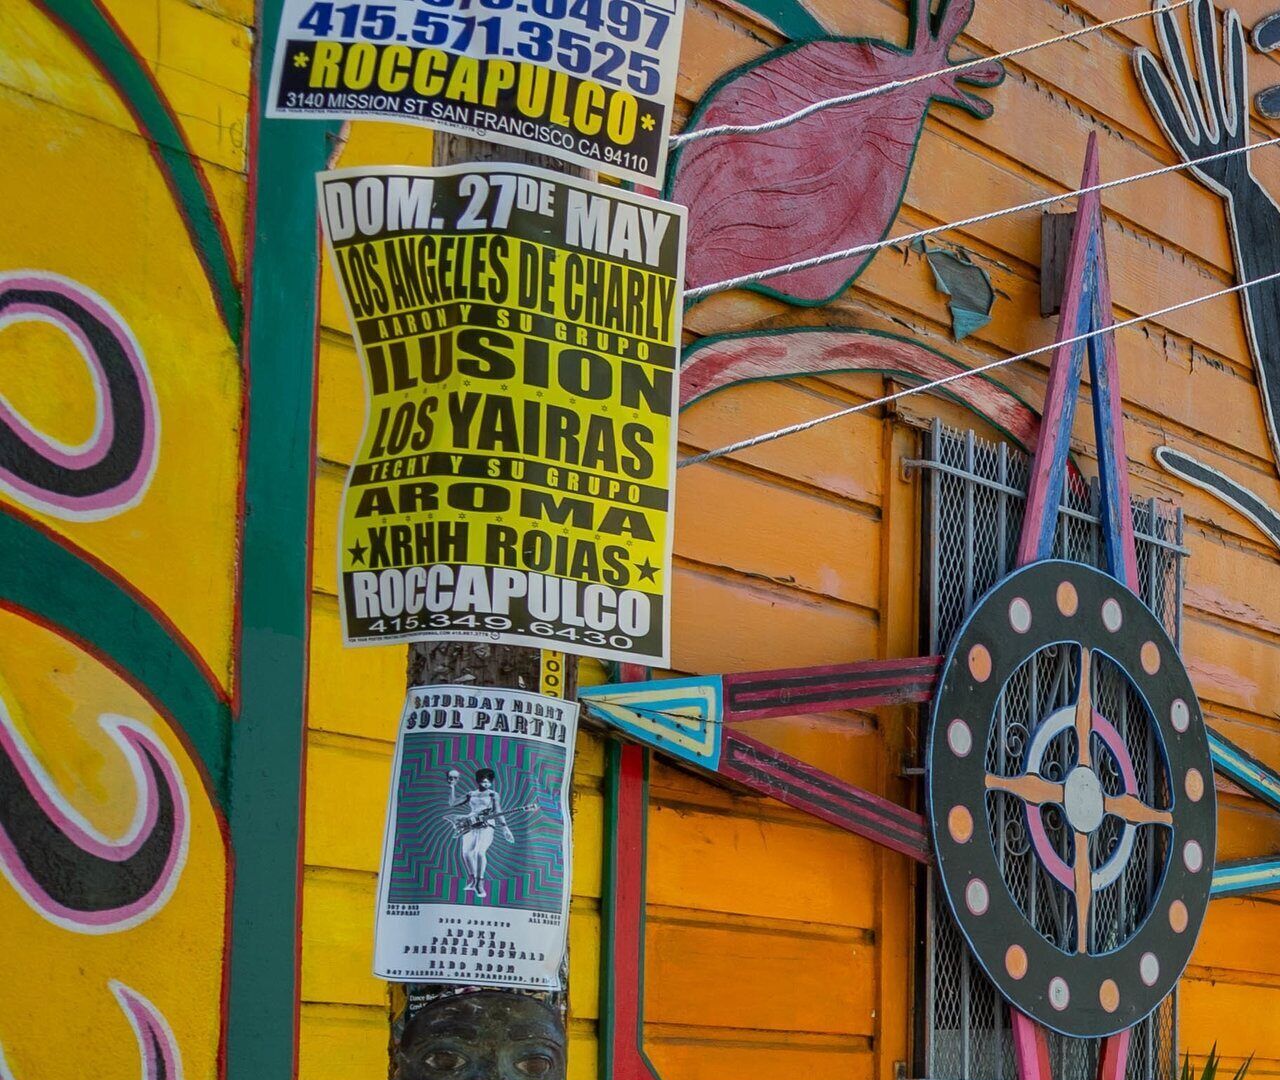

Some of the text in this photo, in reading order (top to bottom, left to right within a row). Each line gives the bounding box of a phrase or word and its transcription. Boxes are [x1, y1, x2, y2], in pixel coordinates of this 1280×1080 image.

[297, 2, 661, 96] 415.571.3525
[309, 41, 637, 146] ROCCAPULCO
[287, 92, 324, 108] 3140
[327, 94, 401, 113] MISSION
[403, 98, 428, 115] ST
[430, 102, 468, 125] SAN
[473, 109, 574, 152] FRANCISCO
[577, 137, 601, 160] CA
[604, 145, 648, 172] 94110
[325, 177, 444, 242] DOM.
[565, 190, 671, 268] MAY
[335, 235, 677, 343] LOS ANGELES DE CHARLY
[379, 304, 649, 362] AARON Y SU GRUPO
[364, 329, 674, 416] ILUSION
[370, 391, 654, 479] LOS YAIRAS
[355, 482, 655, 543] AROMA
[370, 456, 641, 503] TECHY Y SU GRUPO
[352, 564, 652, 637] ROCCAPULCO
[368, 612, 634, 650] 415.349.6430
[406, 709, 566, 743] SOUL PARTY!
[415, 695, 564, 721] SATURDAY NIGHT
